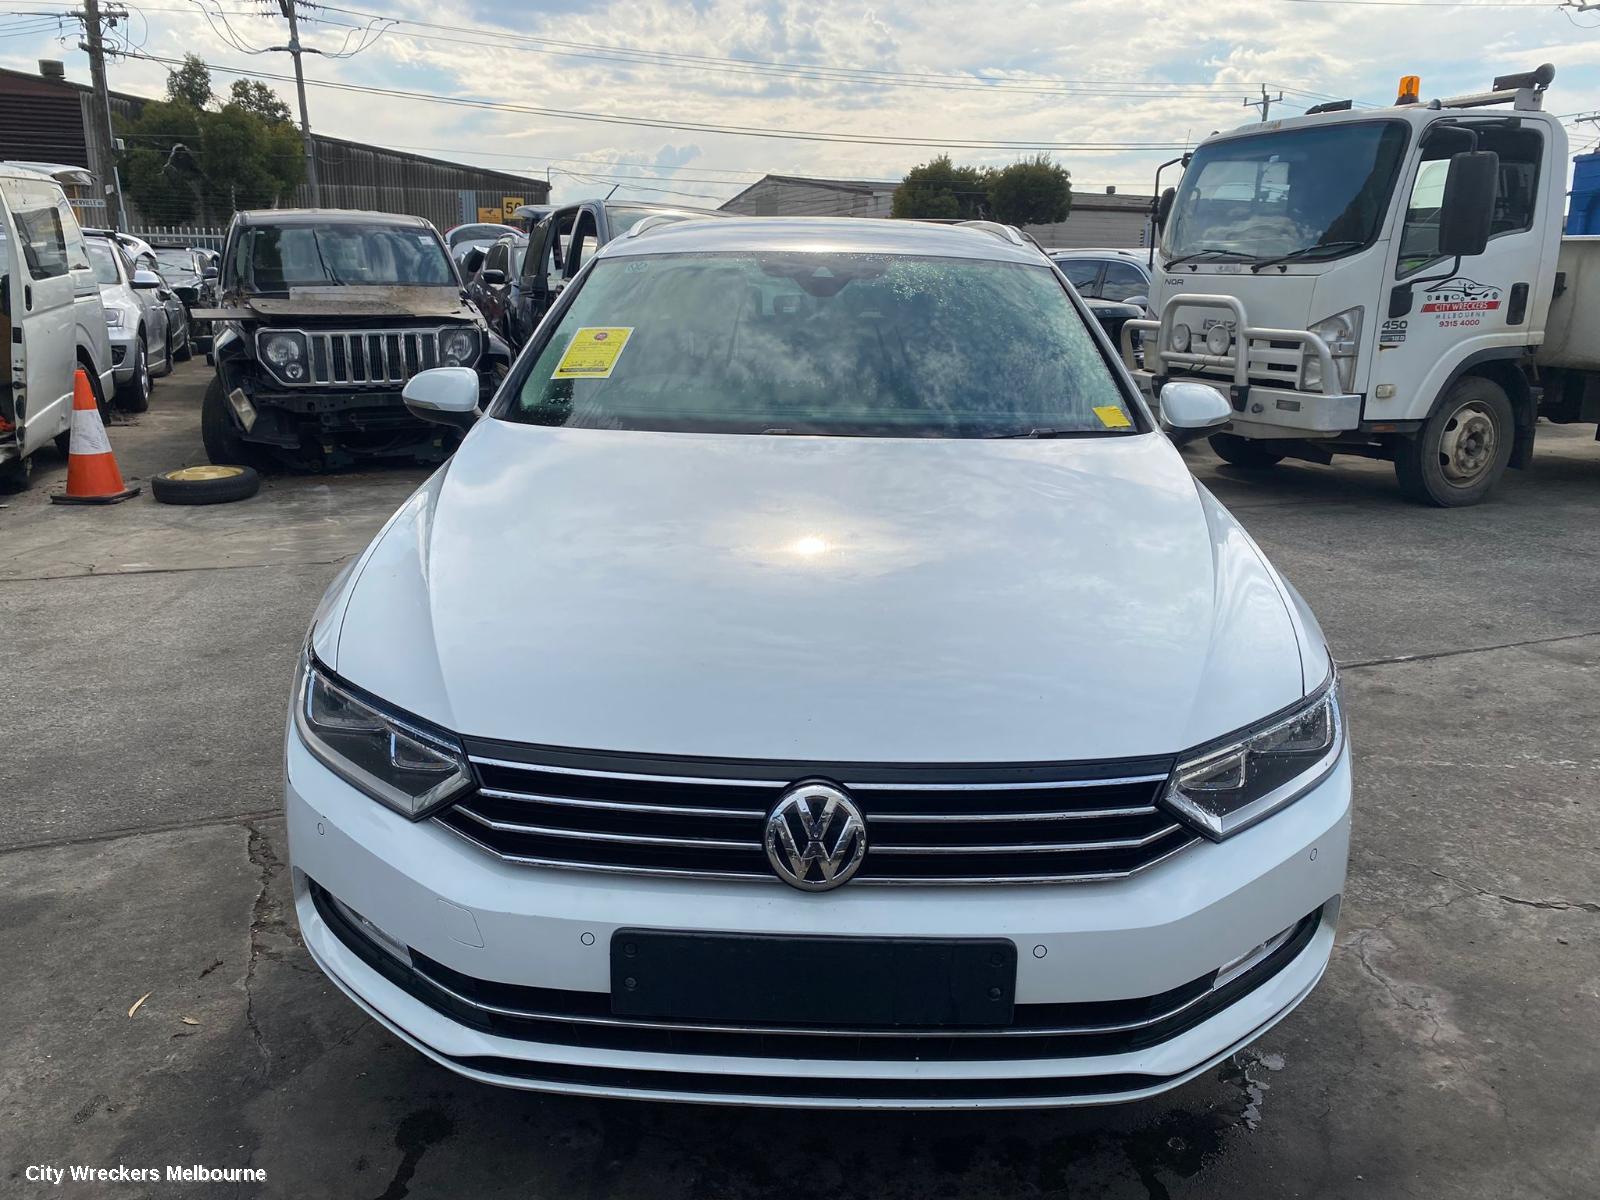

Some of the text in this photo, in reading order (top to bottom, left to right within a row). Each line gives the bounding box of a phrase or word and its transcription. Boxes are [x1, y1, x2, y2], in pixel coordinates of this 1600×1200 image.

[1435, 302, 1488, 311] CITY WRECKERS
[1436, 311, 1485, 319] MELBOURNE
[1382, 320, 1408, 330] 450
